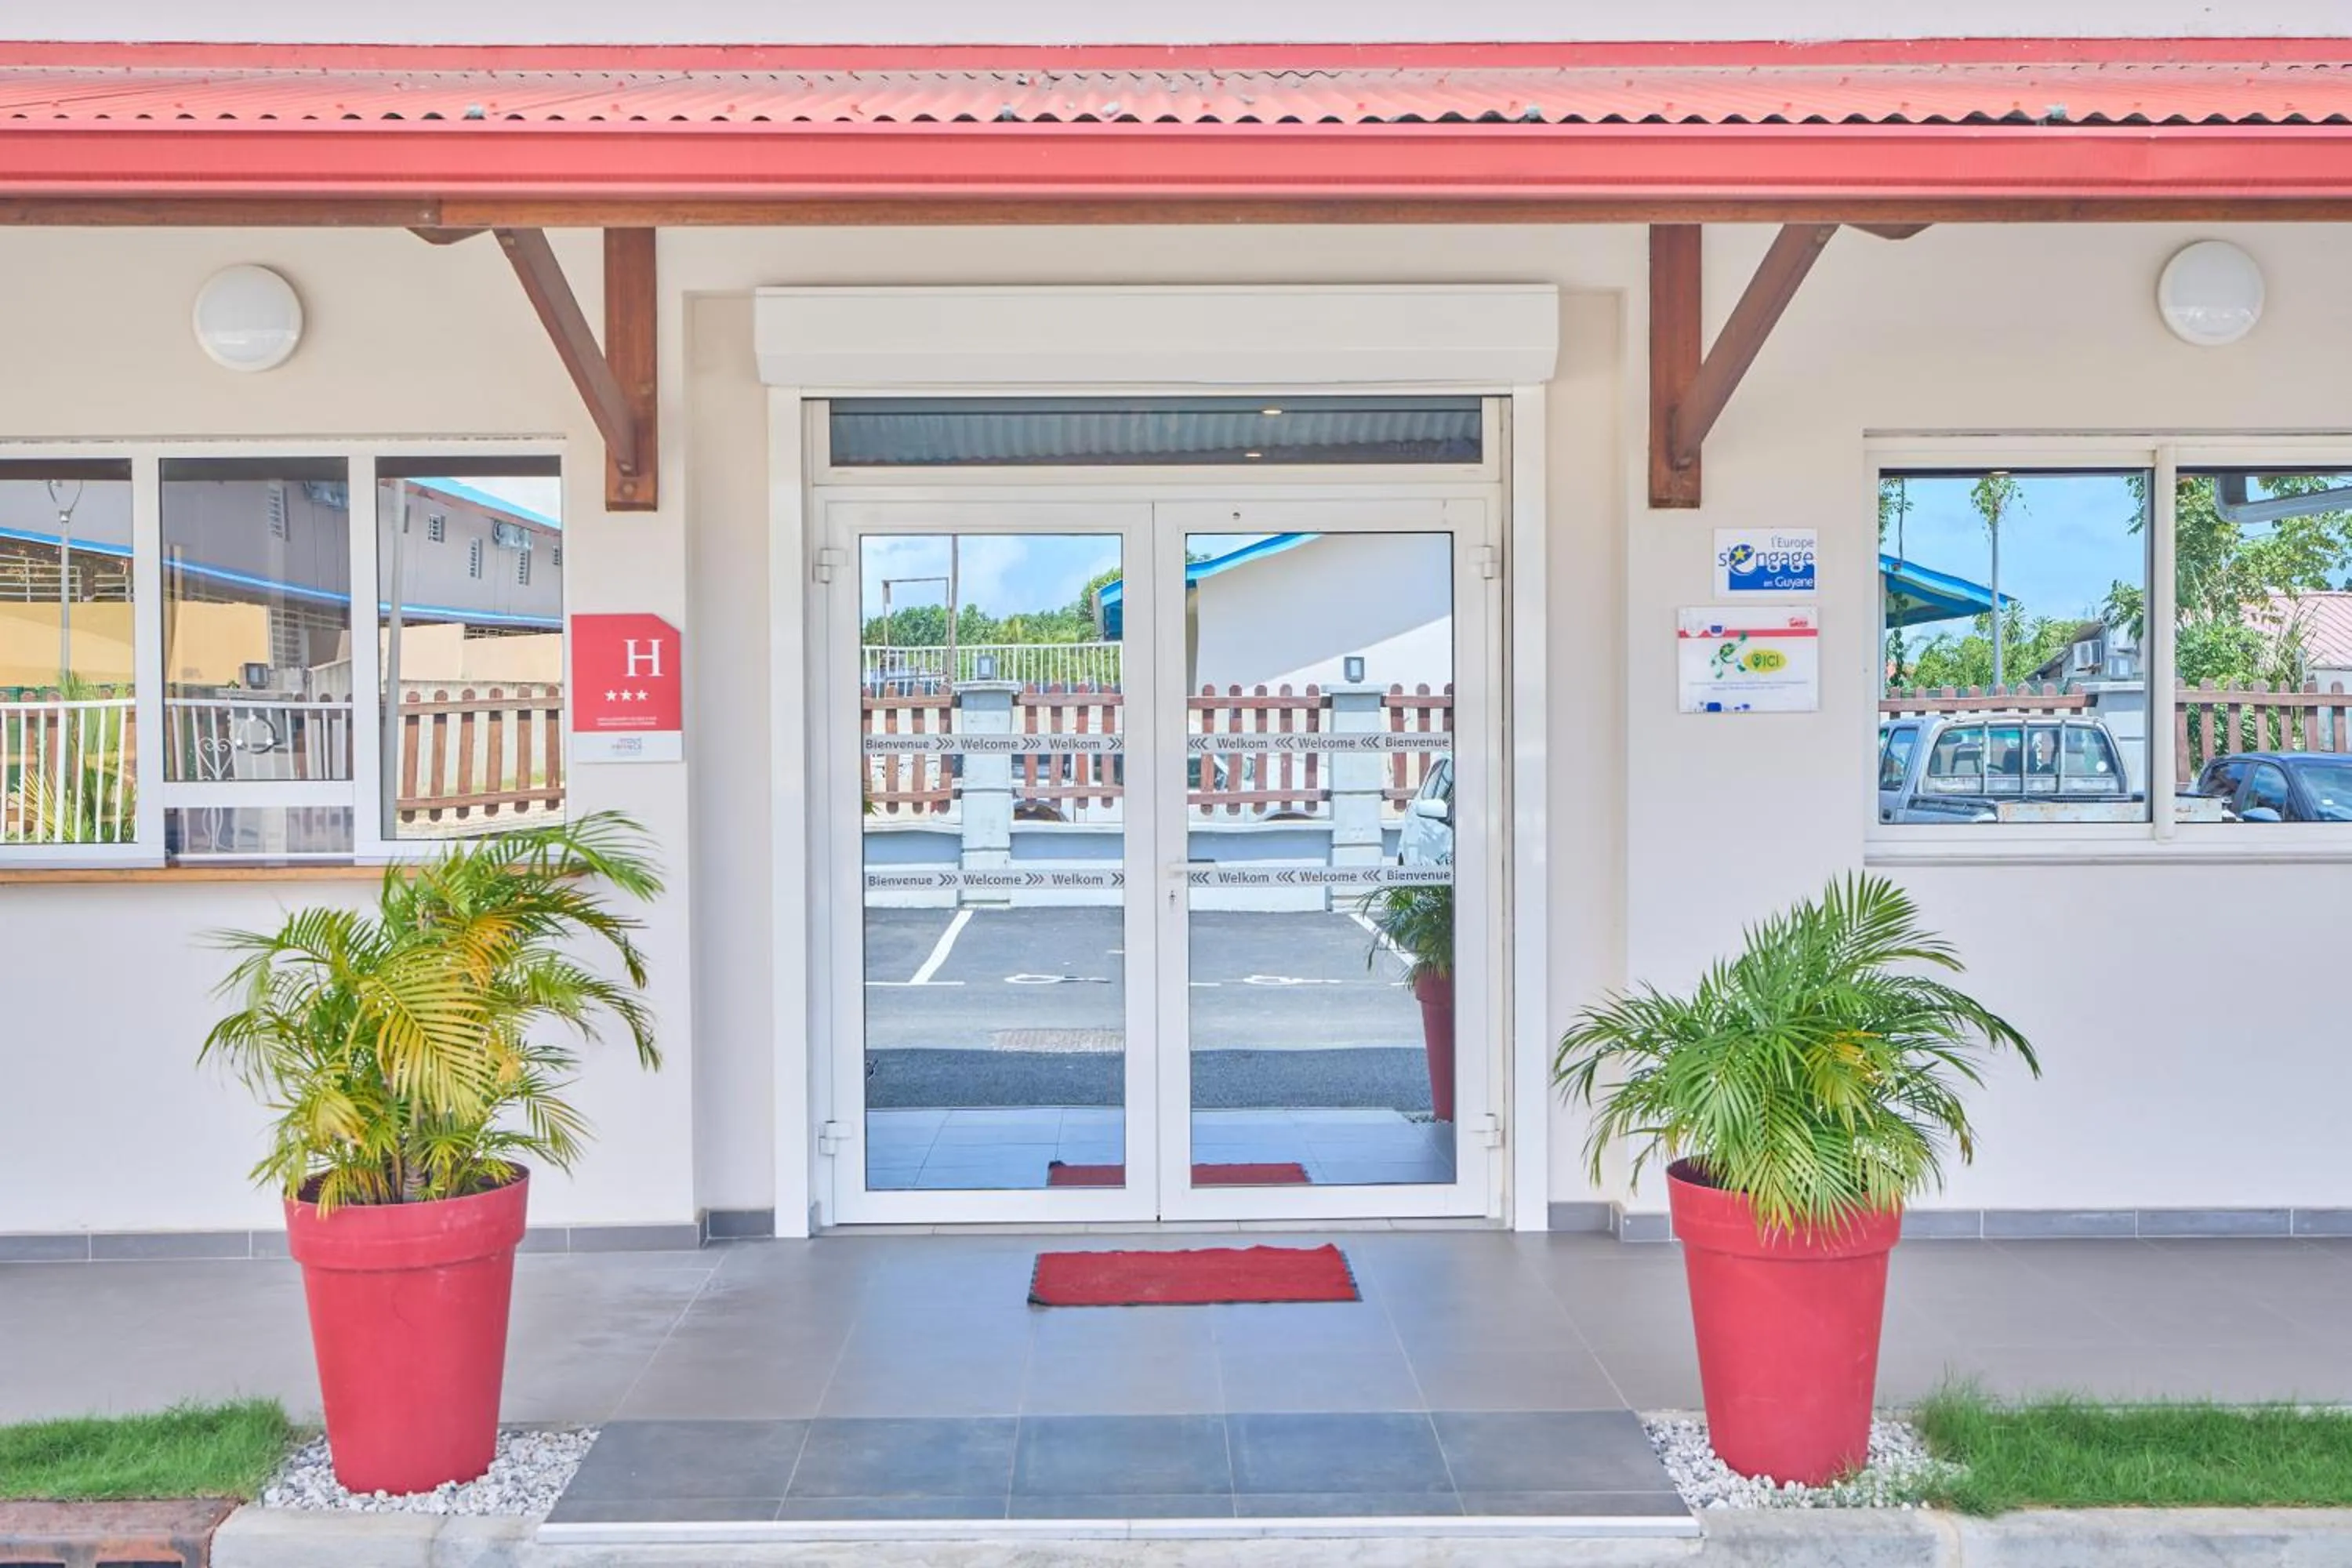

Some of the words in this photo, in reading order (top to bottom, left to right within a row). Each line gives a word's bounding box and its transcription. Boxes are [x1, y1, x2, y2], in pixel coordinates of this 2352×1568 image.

[1771, 535, 1814, 551] l'Europe
[1775, 576, 1813, 590] Guyane
[623, 639, 665, 677] H
[866, 739, 930, 750] Bienvenue
[960, 739, 1018, 750] Welcome
[1048, 739, 1101, 750] Welkom
[1217, 737, 1268, 749] Welkom
[1298, 737, 1356, 749] Welcome
[1385, 737, 1449, 747] Bienvenue
[869, 876, 933, 887] Bienvenue
[964, 874, 1022, 886] Welcome
[1051, 874, 1103, 885] Welkom
[1218, 871, 1269, 884] Welkom
[1299, 871, 1357, 883] Welcome
[1387, 869, 1451, 881] Bienvenue
